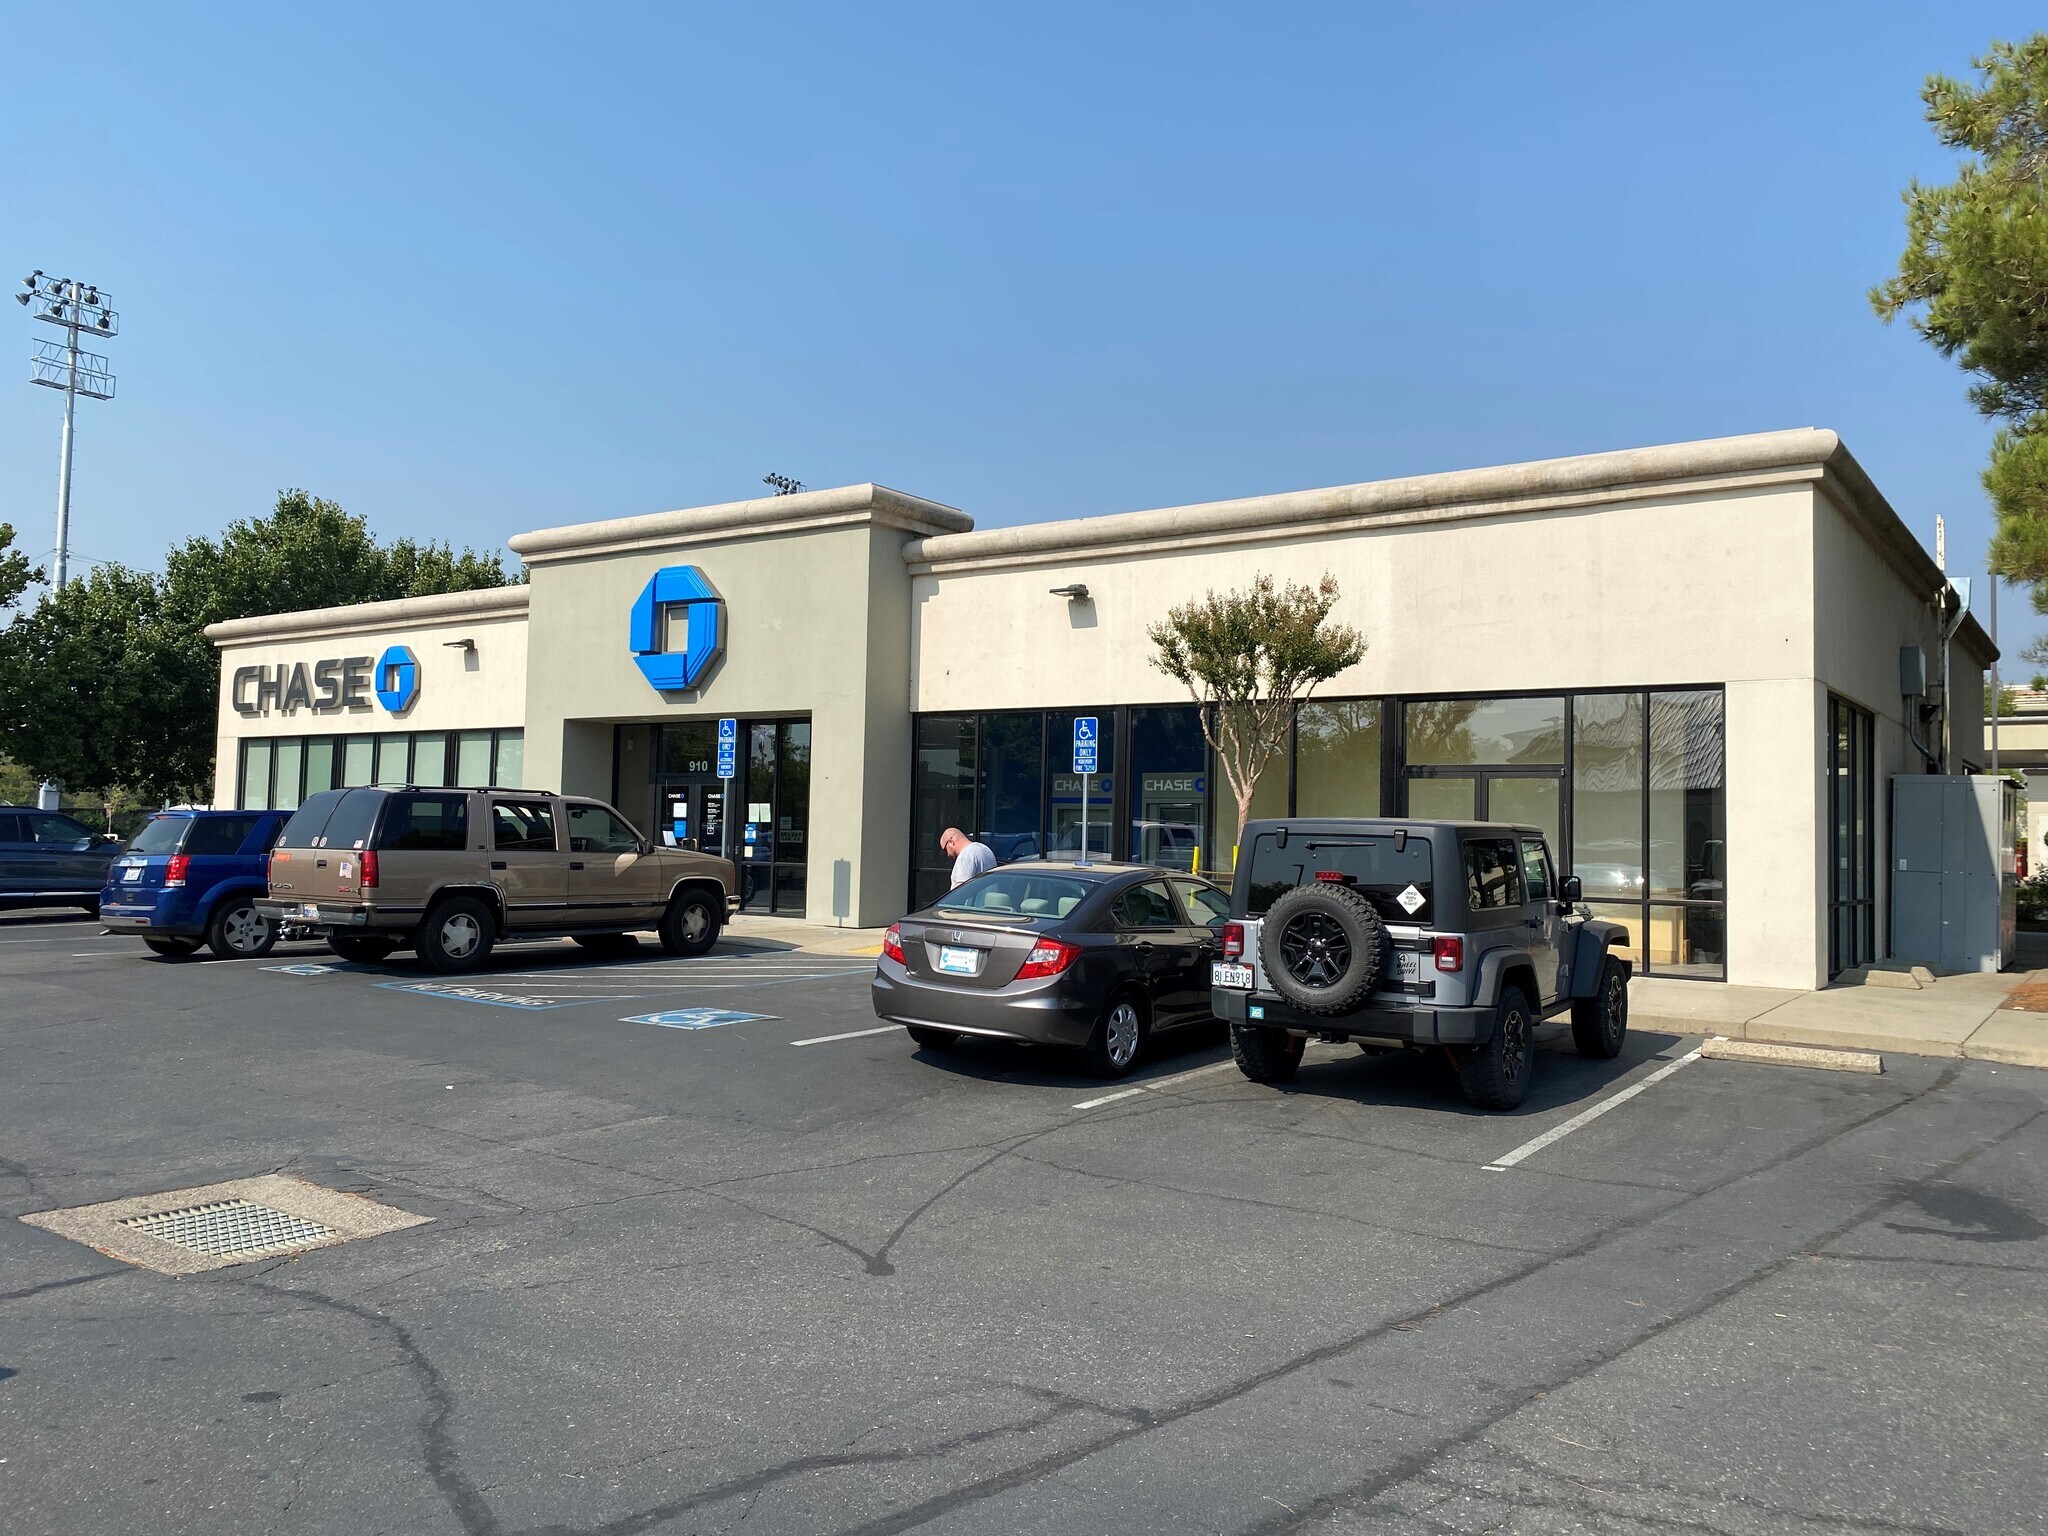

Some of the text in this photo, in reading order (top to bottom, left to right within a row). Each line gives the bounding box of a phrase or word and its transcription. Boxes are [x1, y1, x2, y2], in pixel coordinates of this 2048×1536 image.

[232, 656, 373, 716] CHASE
[1075, 739, 1096, 748] PARKING
[1079, 748, 1092, 756] ONLY
[689, 760, 708, 772] 910
[1144, 779, 1193, 791] CHASE
[1396, 961, 1417, 969] WHEEL
[1396, 968, 1416, 976] DRIVE
